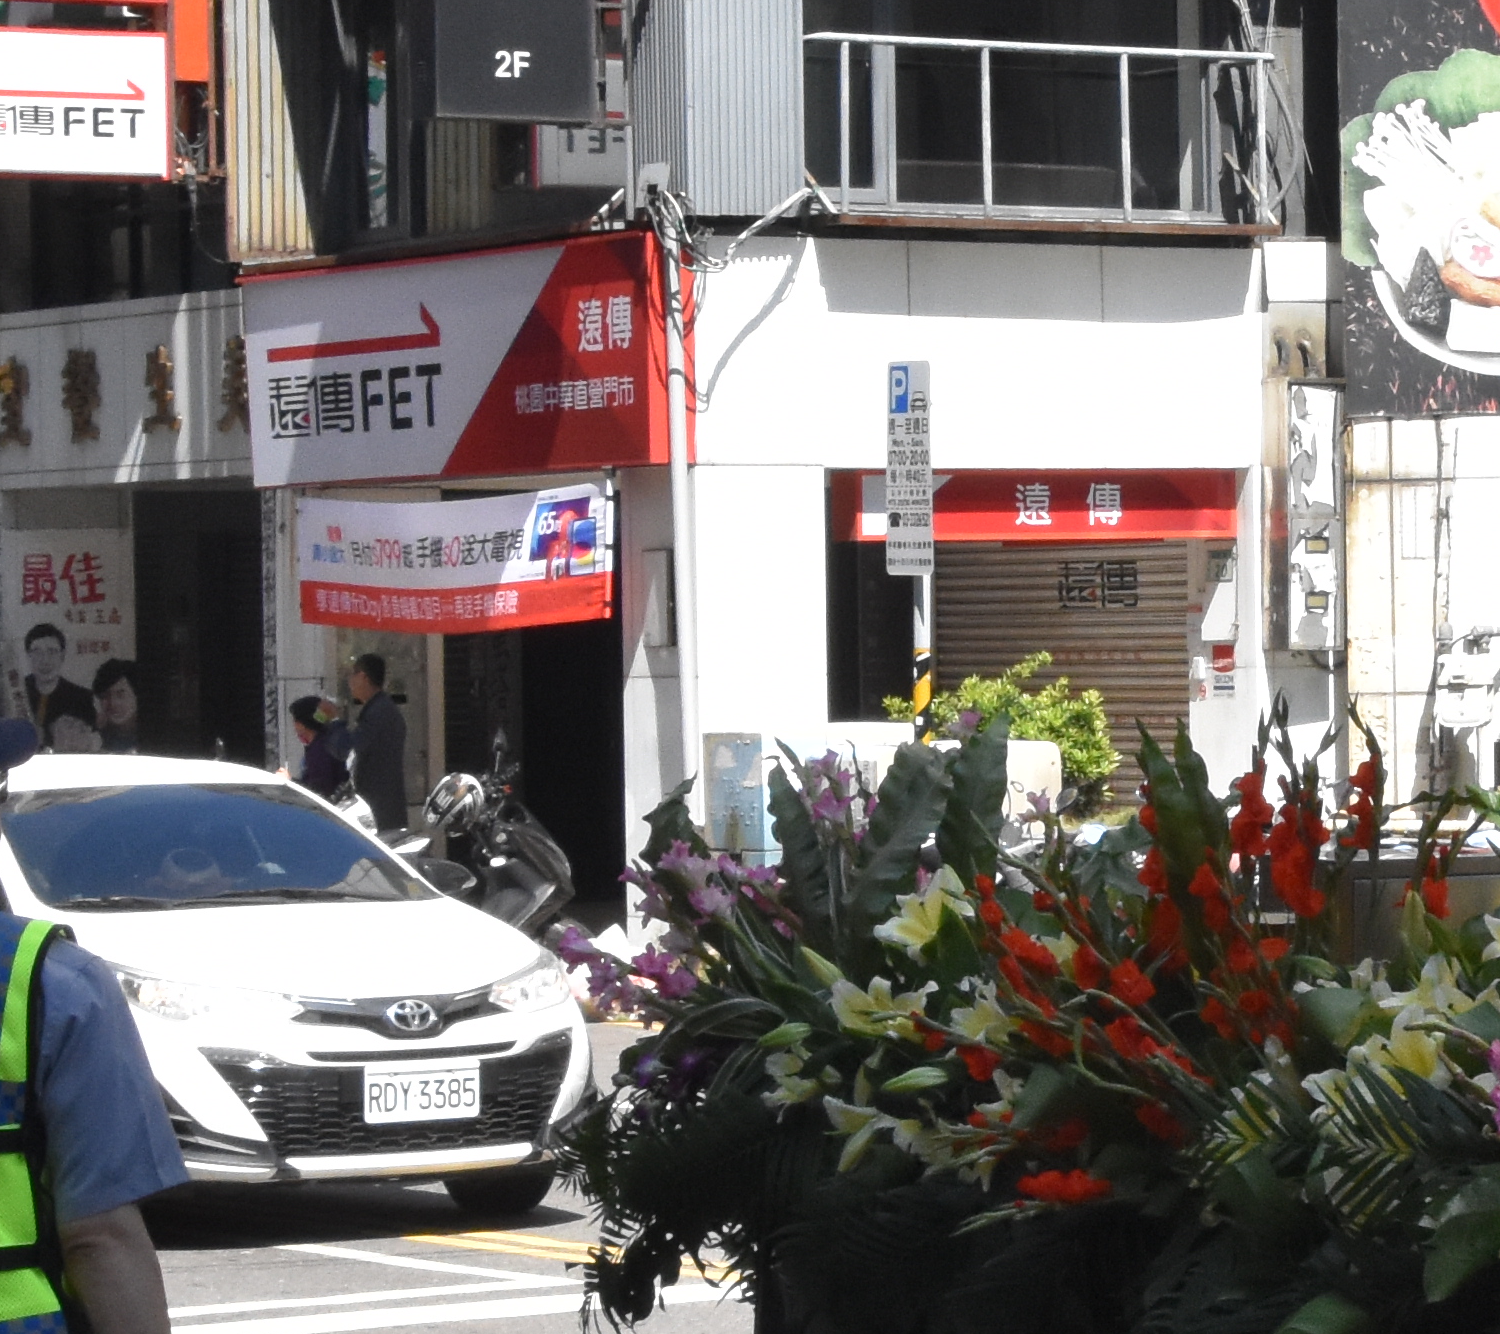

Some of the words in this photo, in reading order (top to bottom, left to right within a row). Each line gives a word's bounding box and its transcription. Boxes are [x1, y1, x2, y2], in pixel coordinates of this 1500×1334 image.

[495, 51, 530, 78] 2F
[64, 107, 145, 139] FET
[578, 295, 632, 353] 遠傳
[269, 372, 353, 439] 遠傳
[361, 364, 441, 431] FET
[516, 376, 633, 415] 桃園中華直營門市
[892, 370, 906, 409] P
[1015, 482, 1122, 527] 遠傳
[22, 551, 106, 606] 最佳
[368, 1075, 477, 1114] RDY-3385
